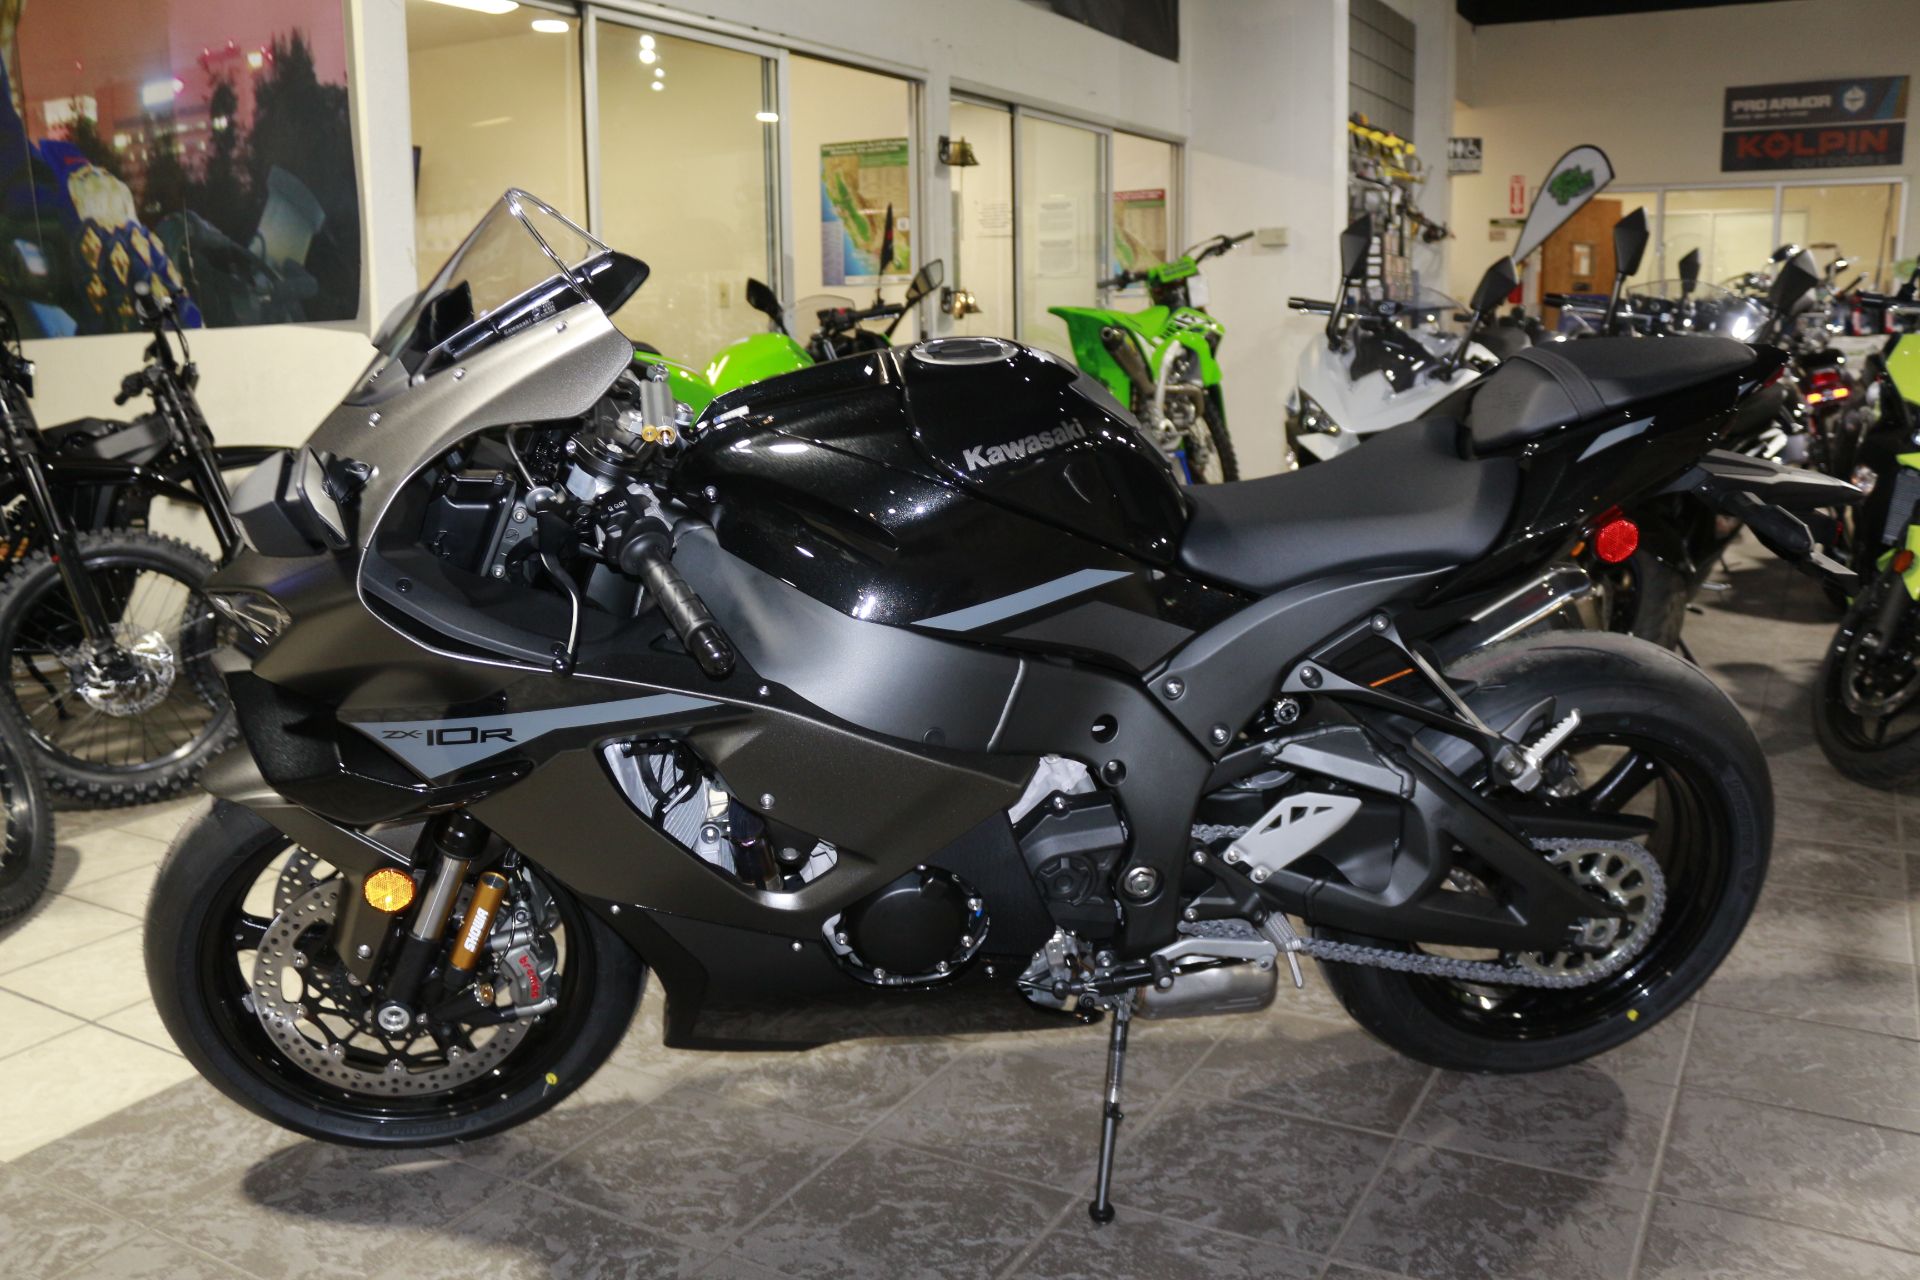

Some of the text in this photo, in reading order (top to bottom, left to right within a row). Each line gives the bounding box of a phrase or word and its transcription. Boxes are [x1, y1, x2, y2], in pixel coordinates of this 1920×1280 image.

[1731, 94, 1832, 112] PRO ARMOR
[1736, 127, 1889, 160] KOLPIN
[962, 417, 1087, 472] Kawasaki
[463, 906, 489, 953] SHOWA
